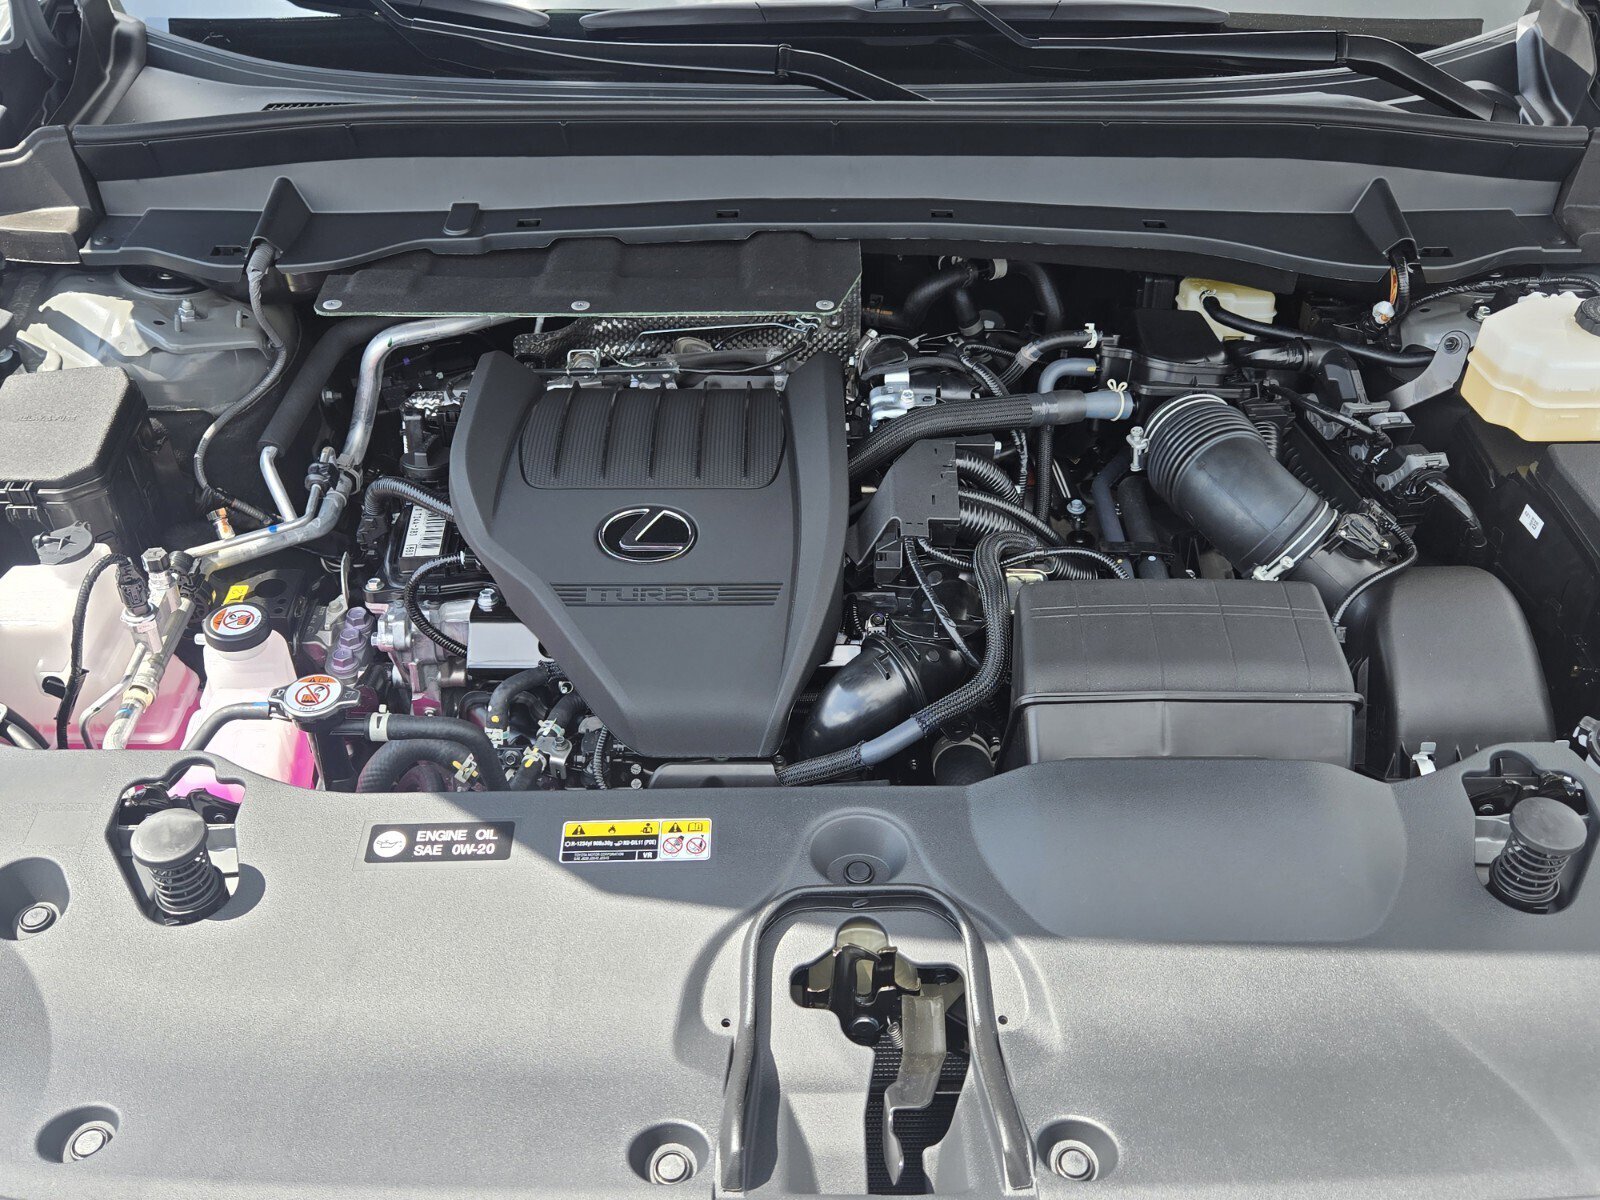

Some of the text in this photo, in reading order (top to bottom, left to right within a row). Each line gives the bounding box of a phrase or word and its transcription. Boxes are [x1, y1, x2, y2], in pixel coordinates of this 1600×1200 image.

[590, 586, 715, 603] TURBO
[416, 828, 499, 842] ENGINE OIL
[413, 842, 496, 857] SAE 0W-20
[642, 851, 653, 859] VR
